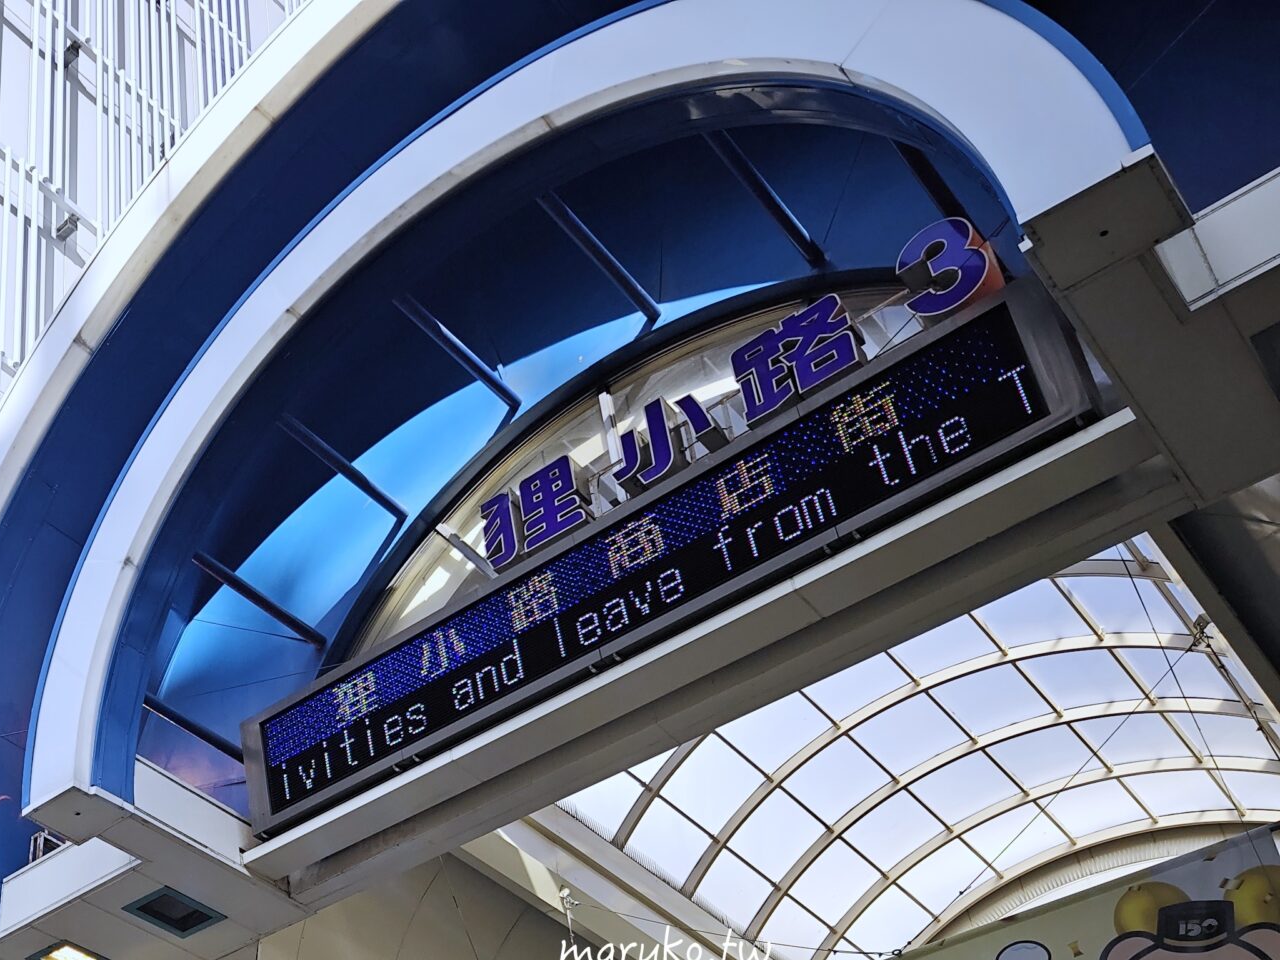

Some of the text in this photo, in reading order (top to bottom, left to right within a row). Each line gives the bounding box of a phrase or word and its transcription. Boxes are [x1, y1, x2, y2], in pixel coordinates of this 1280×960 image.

[281, 364, 1032, 800] ivities and leave from the T
[480, 216, 990, 570] 狸小路 3
